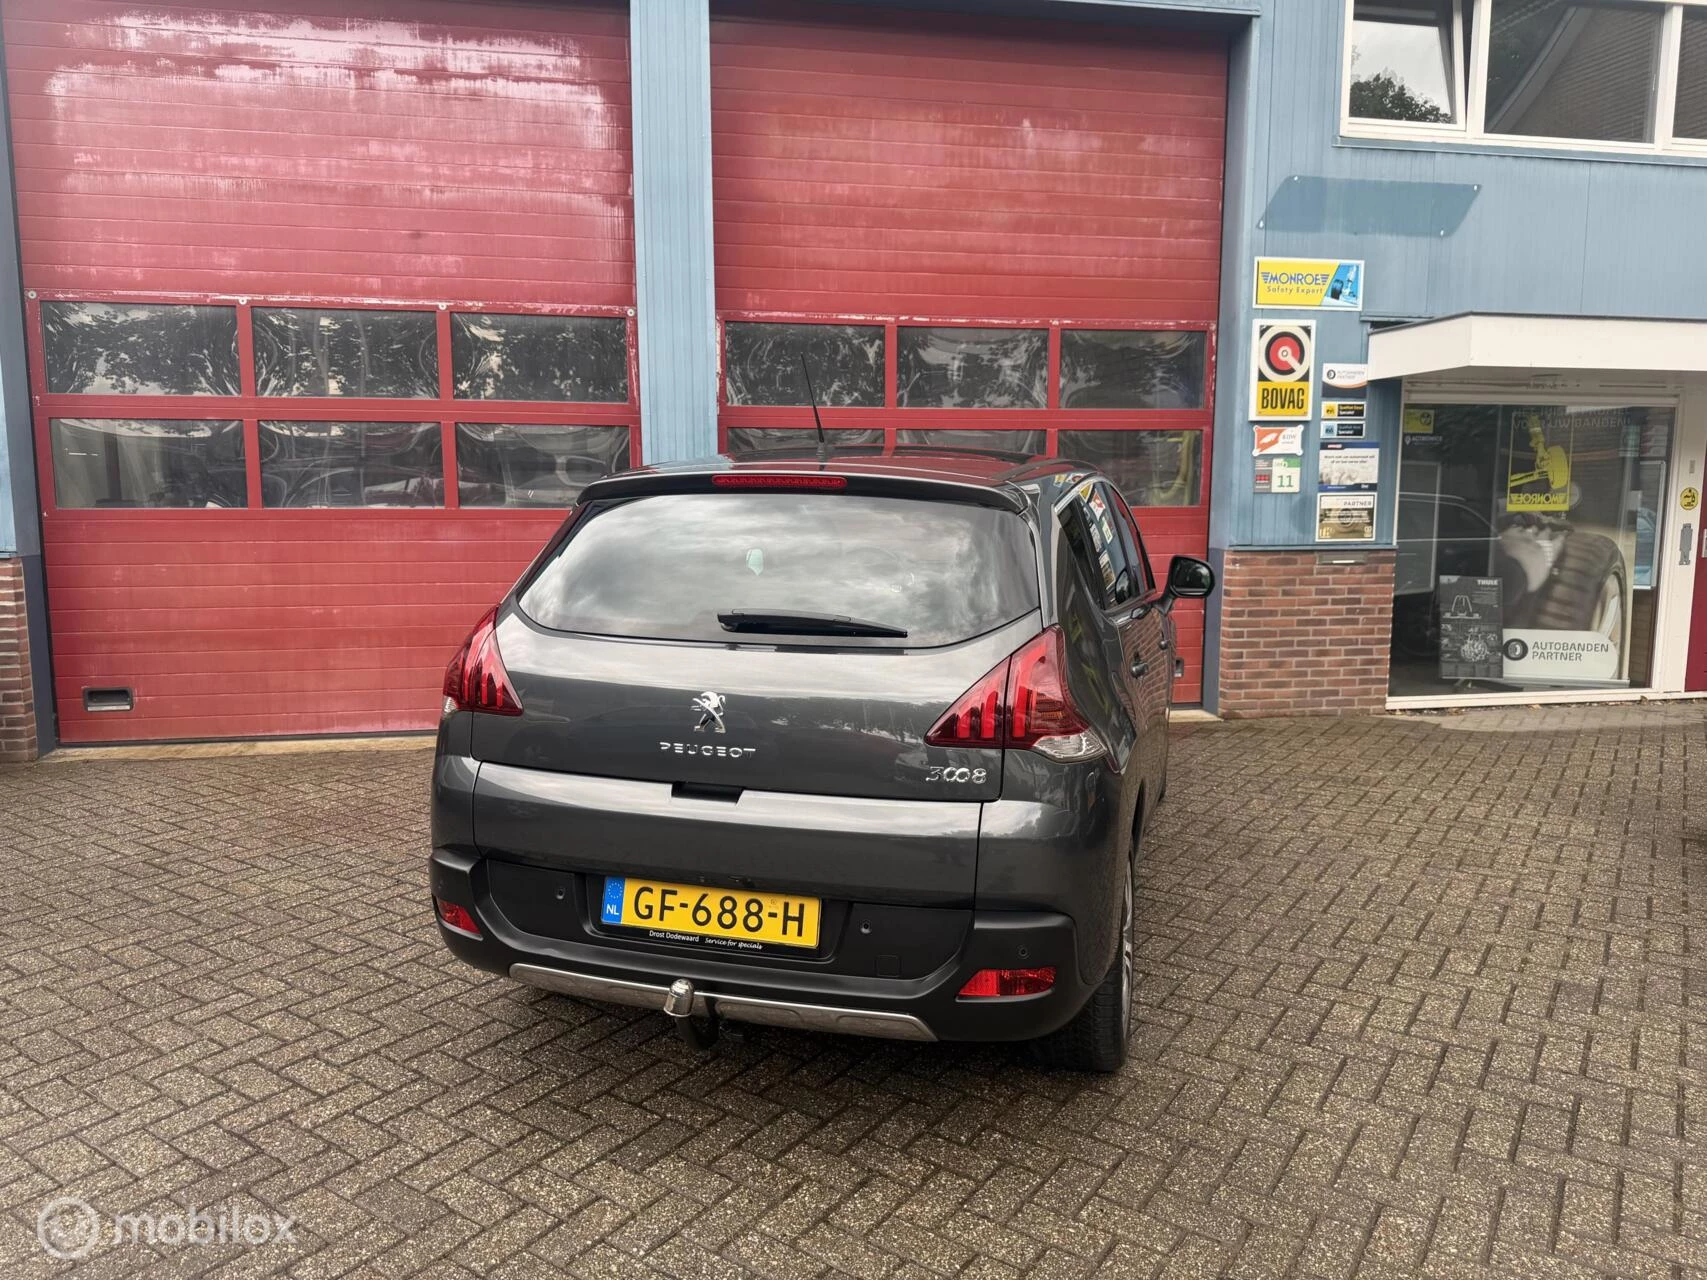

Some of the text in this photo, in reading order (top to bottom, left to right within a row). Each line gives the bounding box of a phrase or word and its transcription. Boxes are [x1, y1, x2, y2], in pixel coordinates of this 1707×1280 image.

[1268, 272, 1322, 286] MONROE
[1266, 285, 1323, 295] Safety Expert
[1261, 387, 1305, 410] BOVAG
[1277, 475, 1294, 488] 11
[1531, 641, 1609, 653] AUTOBANDEN
[1531, 651, 1583, 662] PARTNER
[659, 741, 756, 758] PEUGEOT
[925, 765, 988, 785] 3008
[606, 904, 619, 916] NL
[633, 886, 805, 937] GF-688-H
[648, 929, 763, 950] Drost Dodewaard Service for specials
